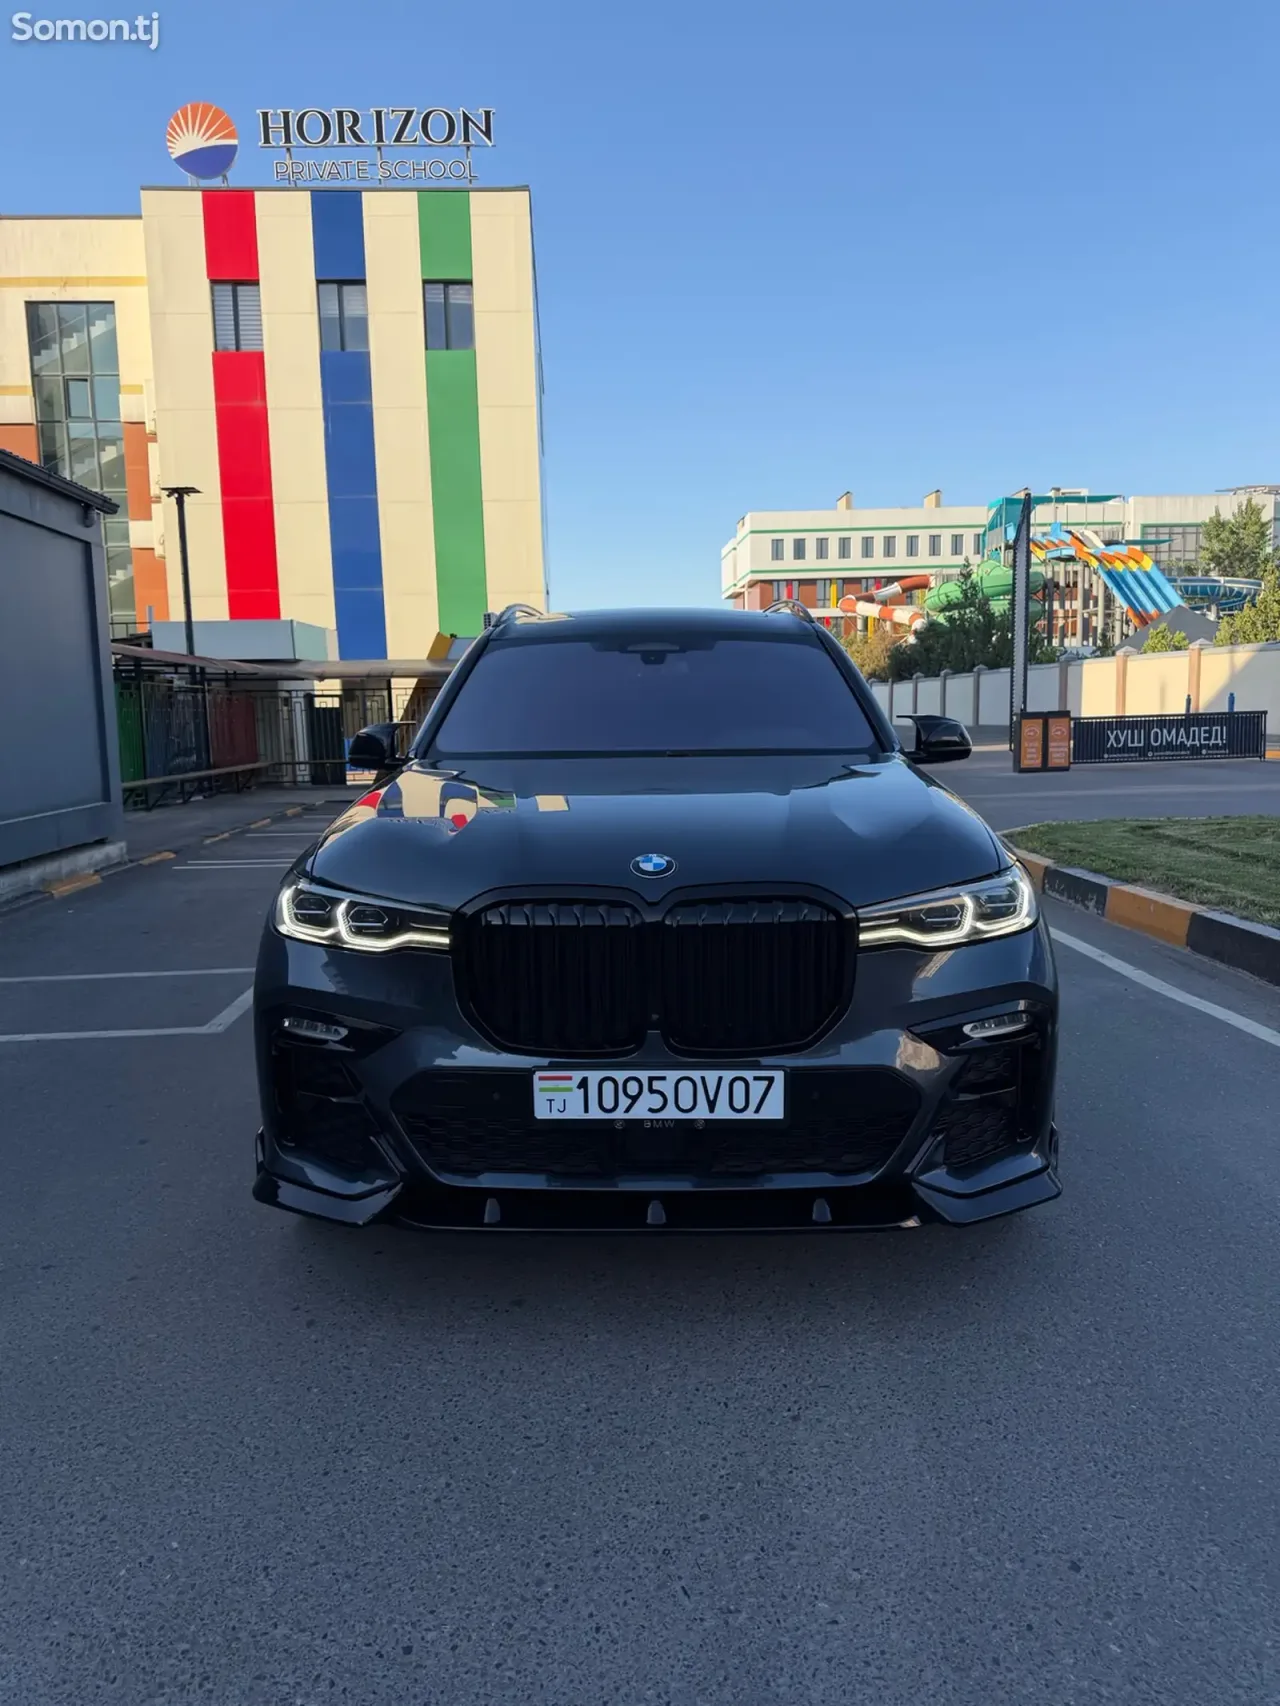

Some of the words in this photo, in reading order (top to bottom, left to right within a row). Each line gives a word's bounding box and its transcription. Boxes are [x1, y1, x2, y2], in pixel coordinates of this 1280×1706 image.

[257, 107, 496, 147] HORIZON
[274, 159, 371, 181] PRIVATE
[379, 159, 479, 181] SCHOOL
[1106, 729, 1144, 748] ХУШ
[1150, 725, 1227, 747] ОМАДЕД!
[546, 1098, 567, 1114] TJ
[643, 1119, 675, 1128] BMW
